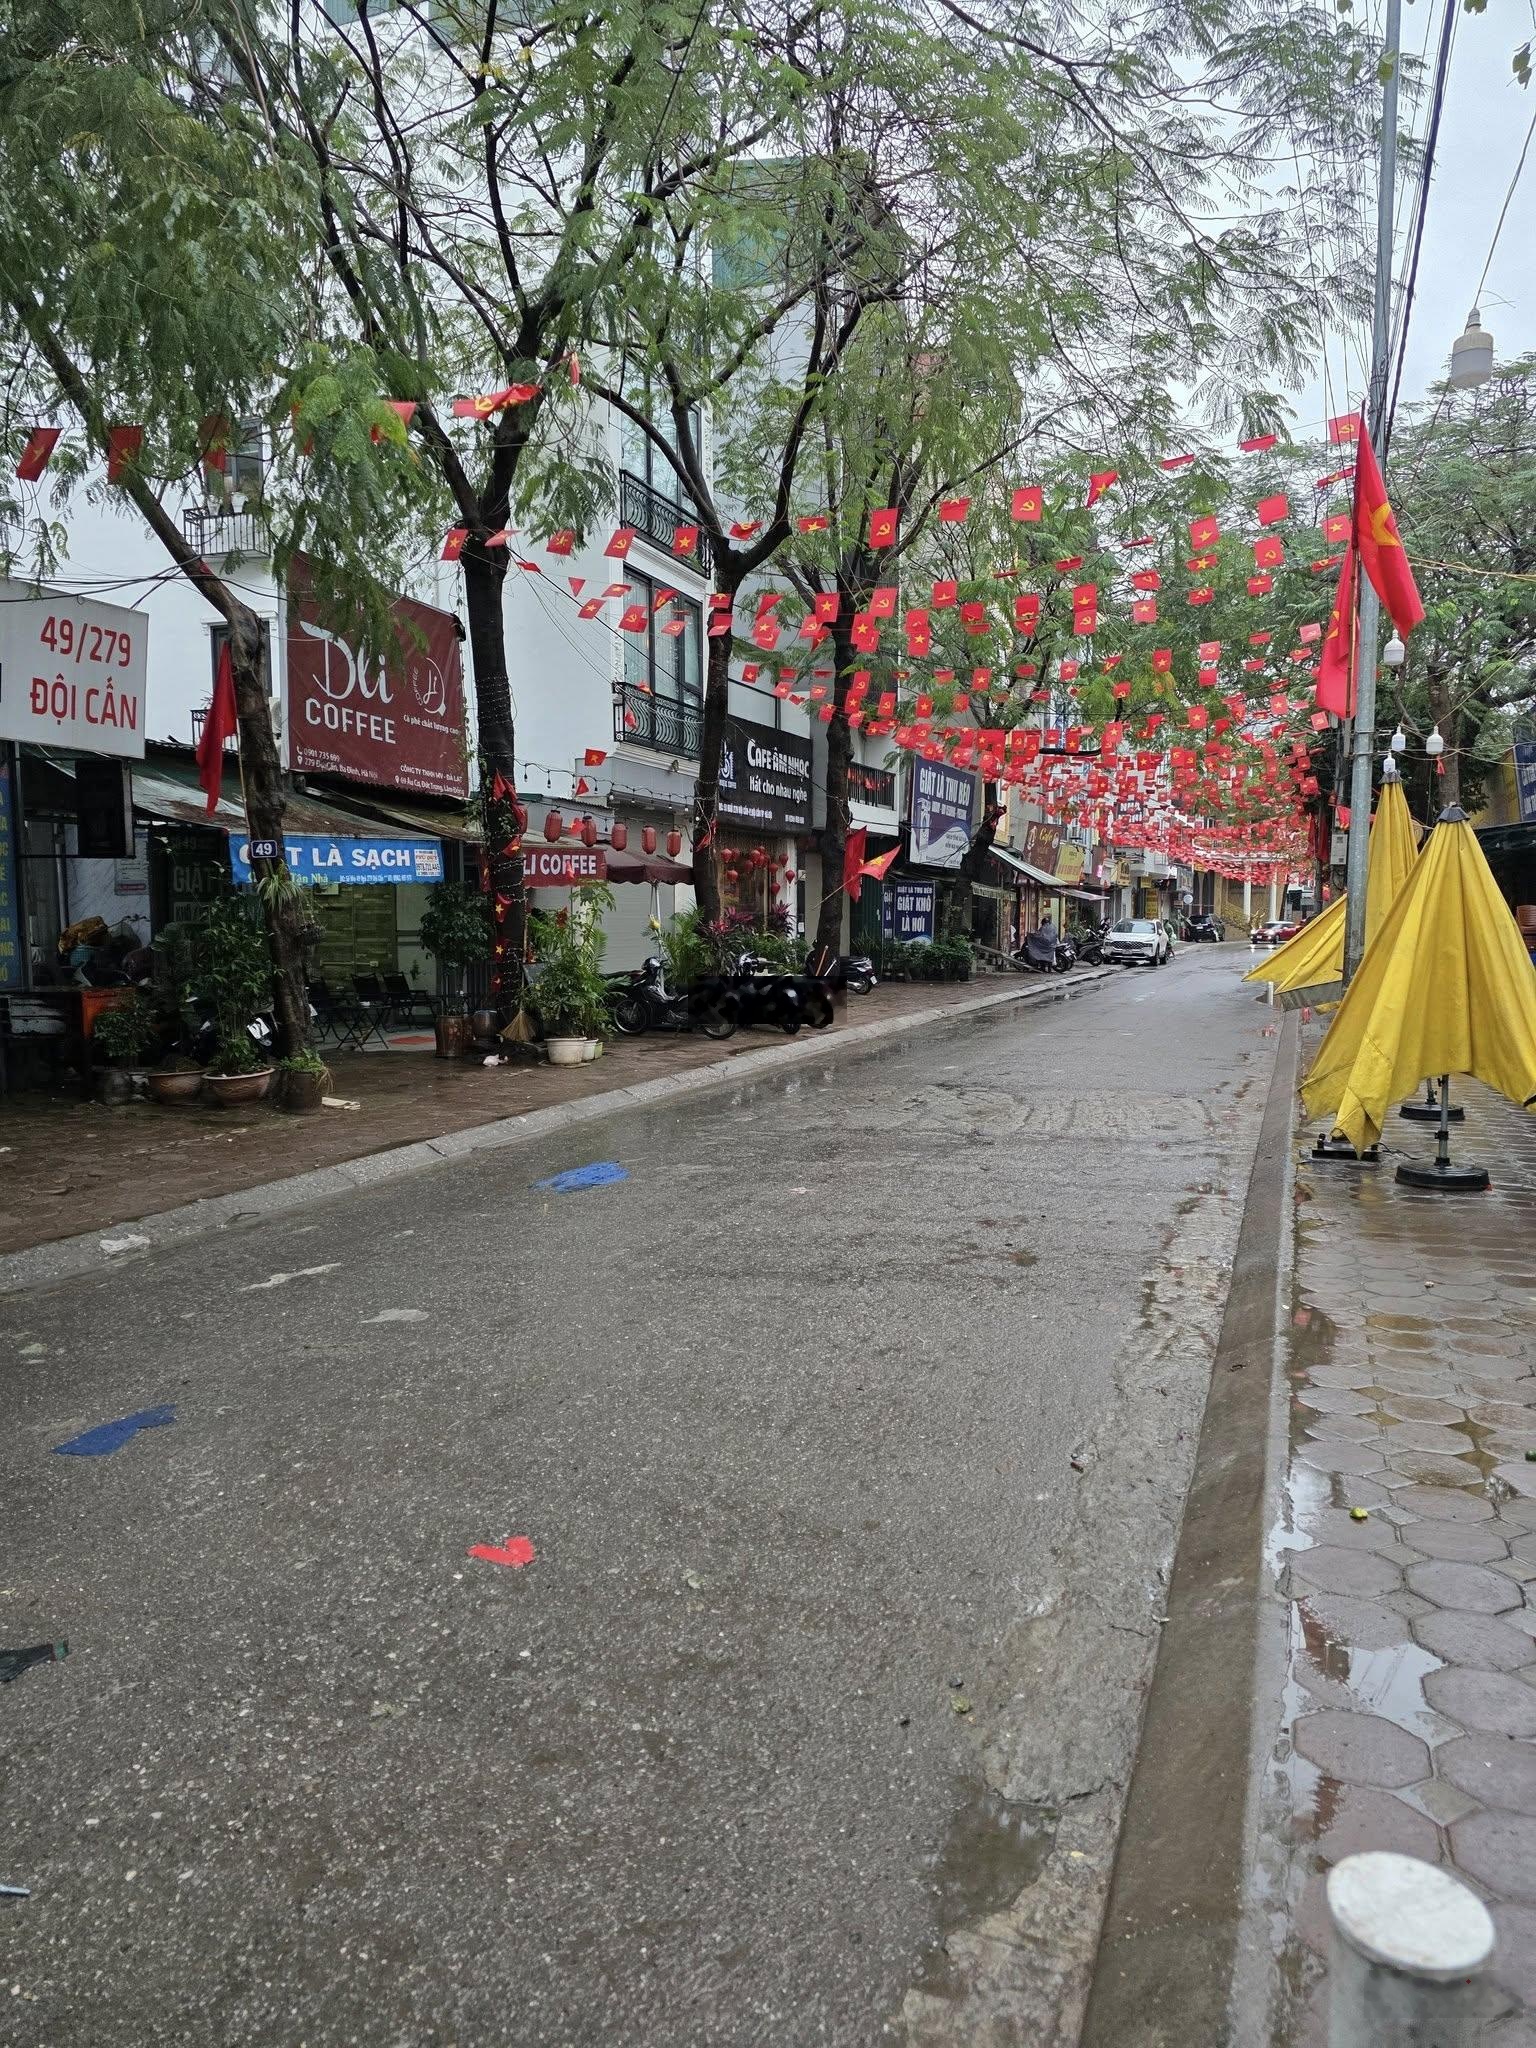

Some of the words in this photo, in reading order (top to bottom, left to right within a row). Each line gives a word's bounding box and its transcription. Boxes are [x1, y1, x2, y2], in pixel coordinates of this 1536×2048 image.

[41, 616, 131, 667] 49/279
[30, 673, 76, 725] ĐỘI
[86, 676, 137, 730] CẤN
[305, 698, 396, 744] COFFEE
[747, 738, 771, 770] CAFE
[749, 775, 762, 792] Hát
[762, 779, 775, 795] cho
[775, 782, 791, 799] nhau
[792, 787, 807, 804] nghe
[255, 843, 273, 856] 49
[312, 843, 343, 867] LÀ
[351, 848, 411, 870] SẠCH
[540, 853, 597, 875] COFFEE
